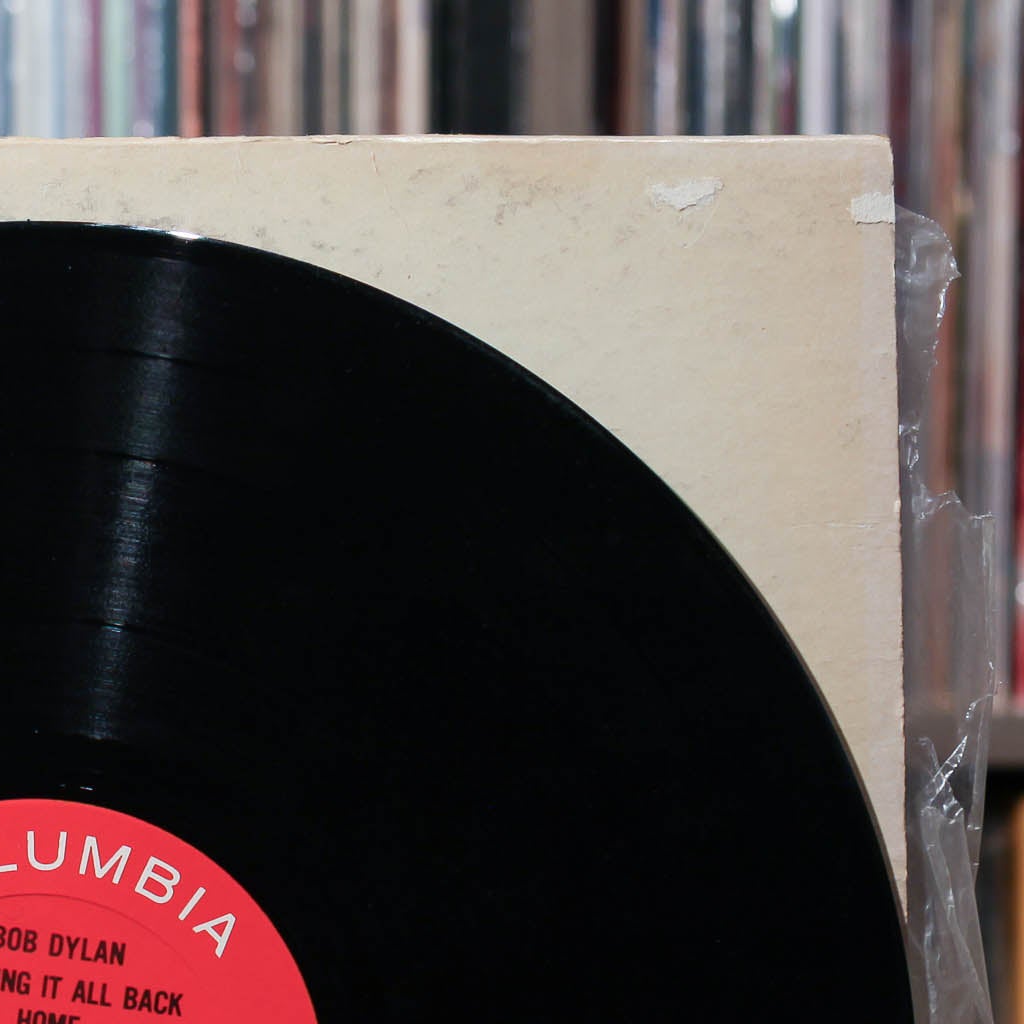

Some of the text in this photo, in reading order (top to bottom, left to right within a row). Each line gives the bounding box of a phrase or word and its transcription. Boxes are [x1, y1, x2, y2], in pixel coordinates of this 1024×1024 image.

[48, 933, 126, 966] DYLAN
[41, 975, 63, 1000] IT
[71, 980, 112, 1007] ALL
[123, 986, 183, 1017] BACK
